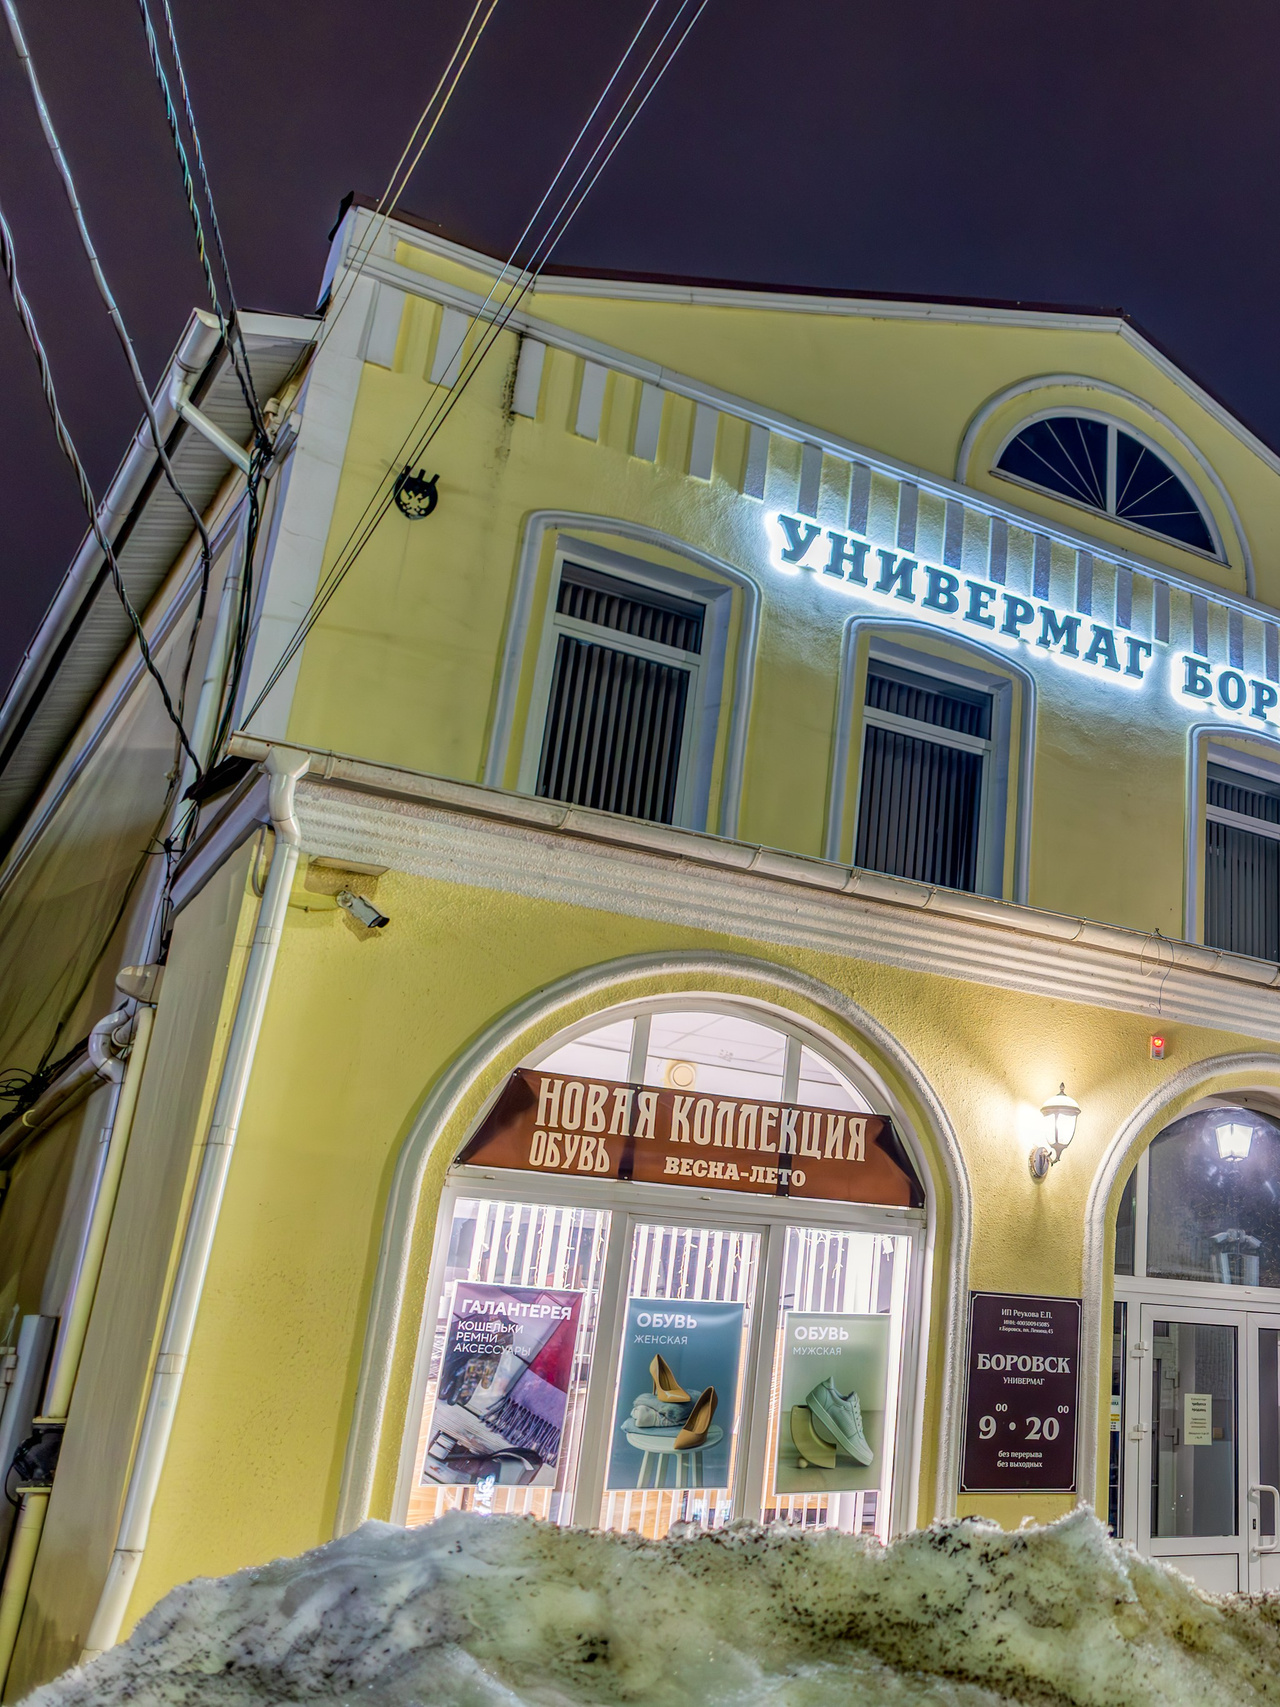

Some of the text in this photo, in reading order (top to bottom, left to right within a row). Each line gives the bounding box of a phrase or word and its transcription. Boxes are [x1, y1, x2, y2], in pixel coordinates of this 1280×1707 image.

[776, 513, 1152, 680] УНИВЕРМАГ
[534, 1077, 868, 1162] НОВАЯ КОЛЛЕКЦИЯ
[528, 1130, 610, 1173] ОБУВЬ
[663, 1156, 807, 1188] ВЕСНА-ЛЕТО
[461, 1299, 572, 1321] ГАЛАНТЕРЕЯ
[1001, 1308, 1012, 1316] ИП
[457, 1320, 524, 1334] КОШЕЛЬКИ
[636, 1312, 698, 1329] ОБУВЬ
[455, 1332, 498, 1343] РЕМНИ
[634, 1334, 688, 1345] ЖЕНСКАЯ
[794, 1326, 849, 1341] ОБУВЬ
[453, 1343, 532, 1357] АКСЕССУАРЫ
[792, 1346, 842, 1356] МУЖСКАЯ
[976, 1353, 1071, 1374] БОРОВСК
[1003, 1376, 1045, 1386] УНИВЕРМАГ
[978, 1415, 997, 1440] 9
[1024, 1416, 1060, 1441] 20
[998, 1450, 1010, 1458] без
[997, 1460, 1042, 1469] без выходных
